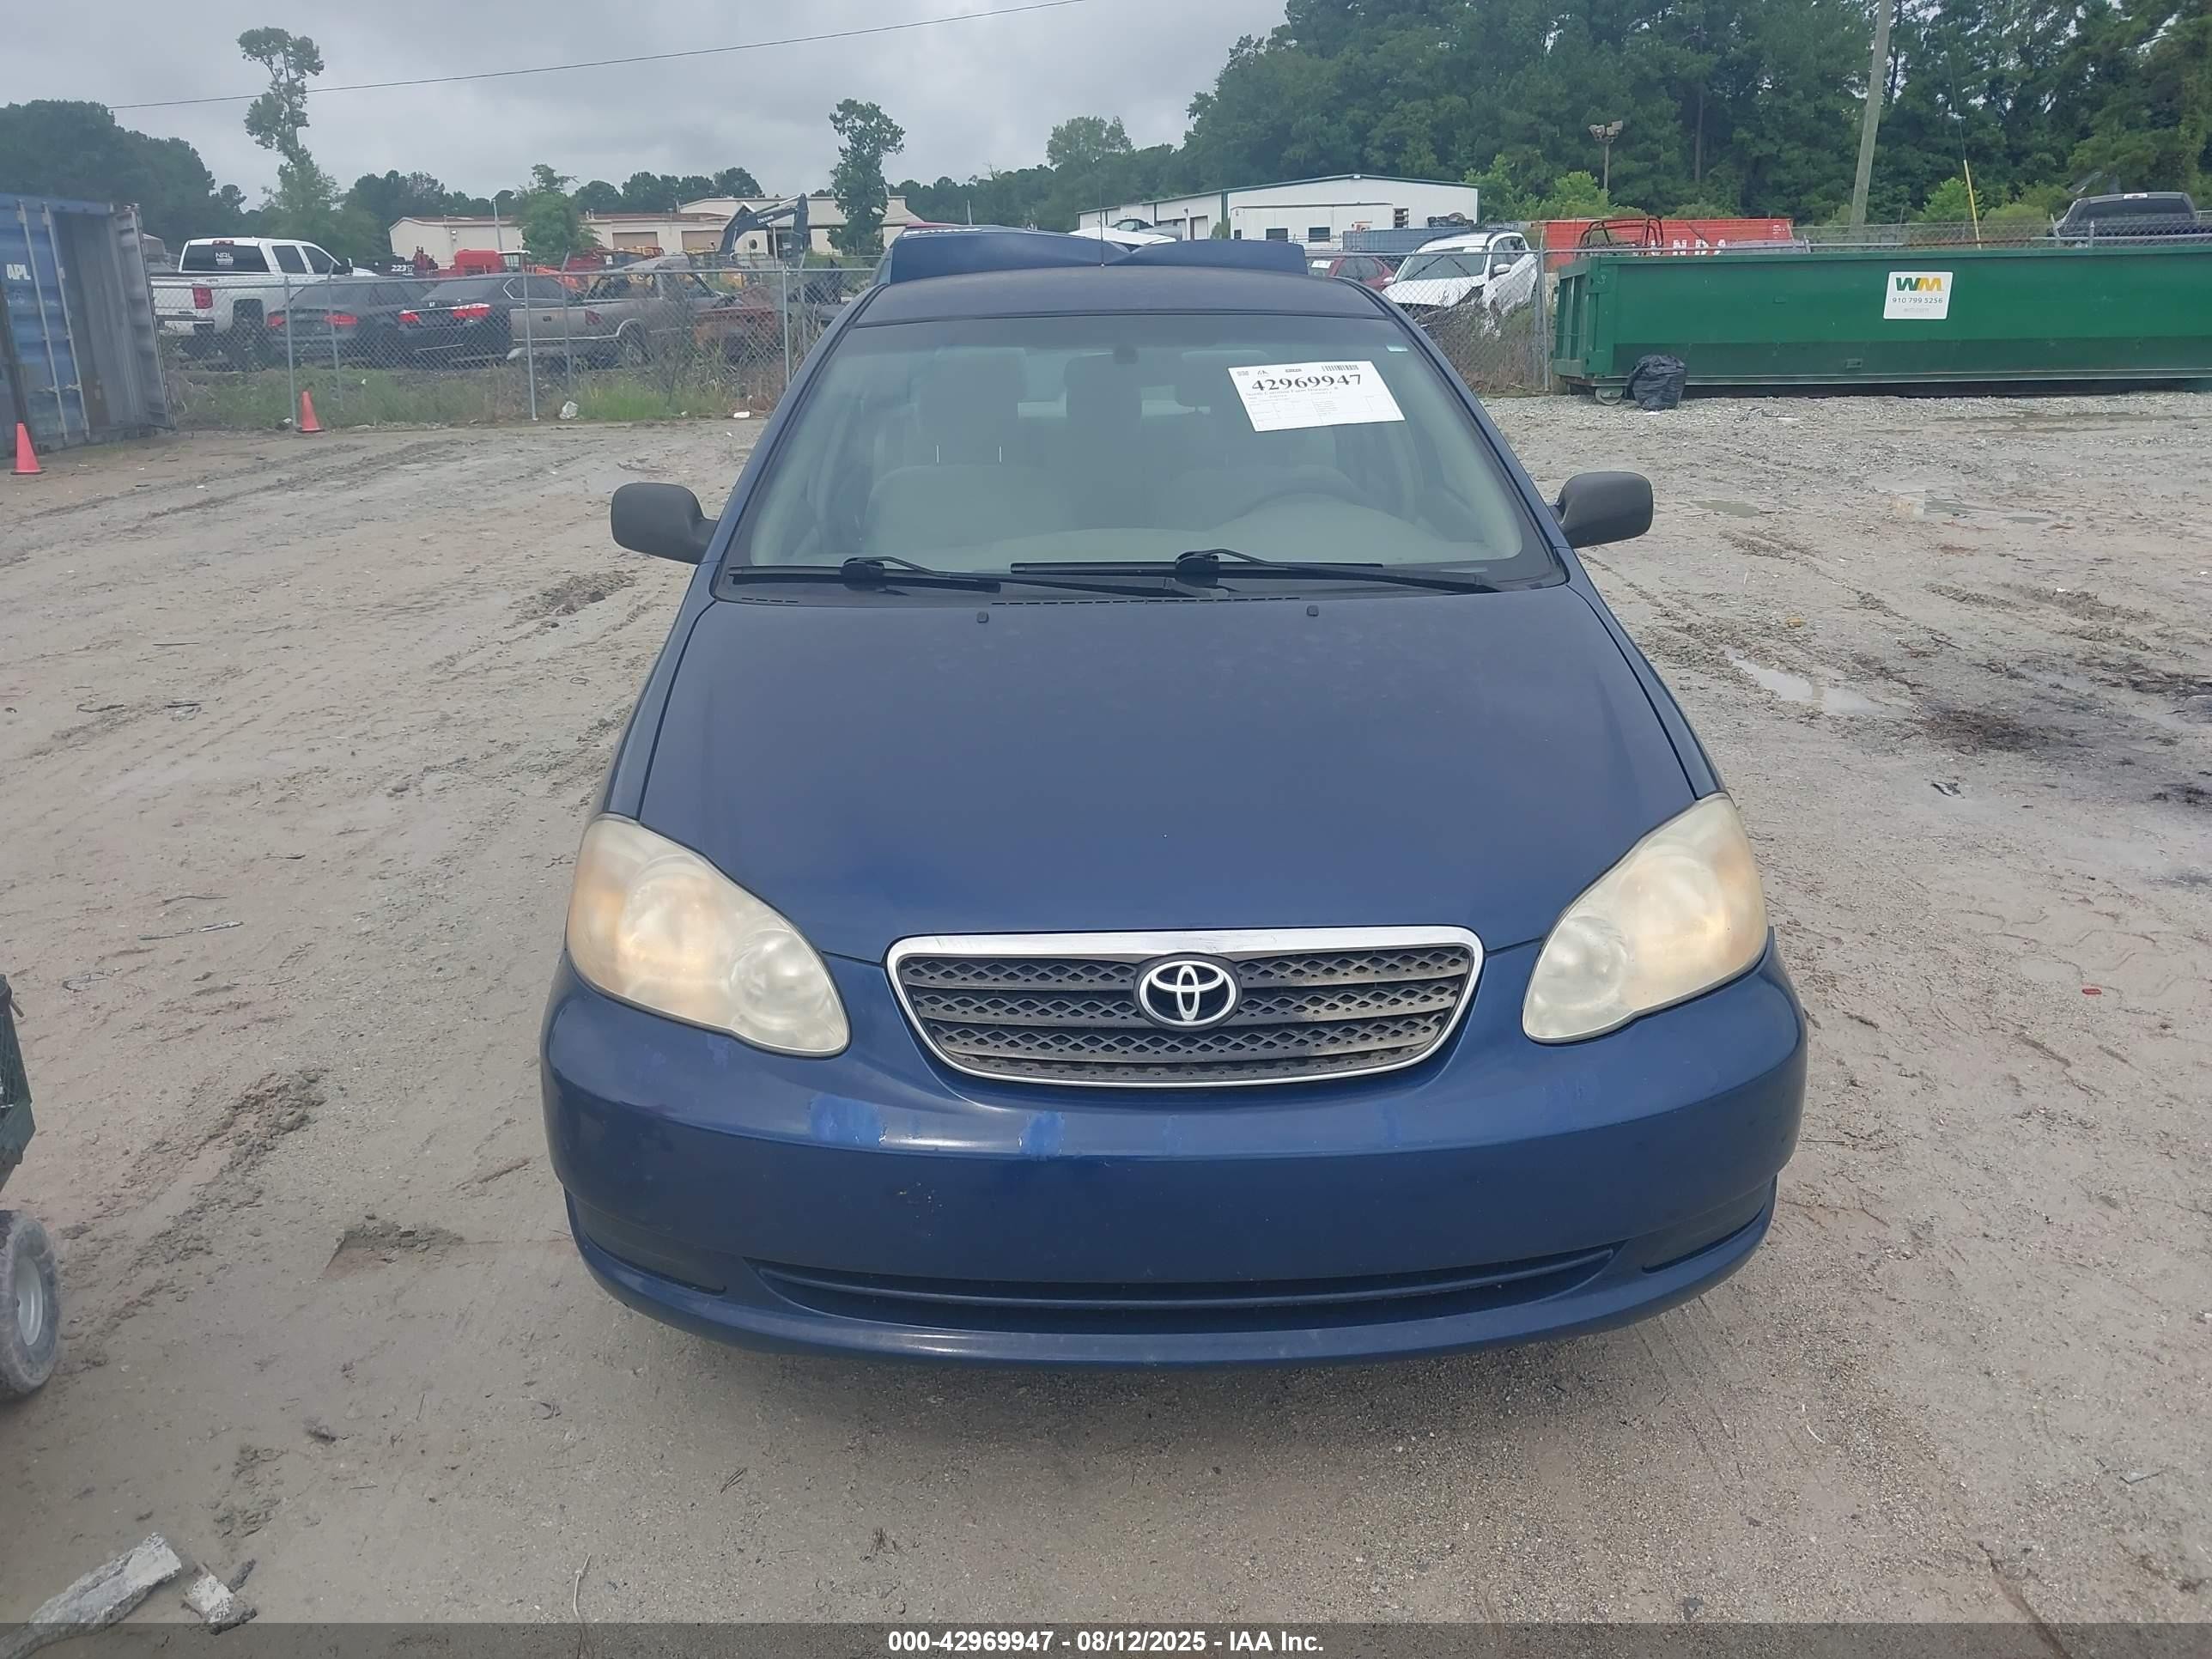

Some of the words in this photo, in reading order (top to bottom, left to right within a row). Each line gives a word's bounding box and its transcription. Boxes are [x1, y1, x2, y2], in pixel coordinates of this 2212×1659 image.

[6, 263, 32, 281] APL
[1895, 277, 1942, 291] WM
[1252, 374, 1361, 391] 42969947
